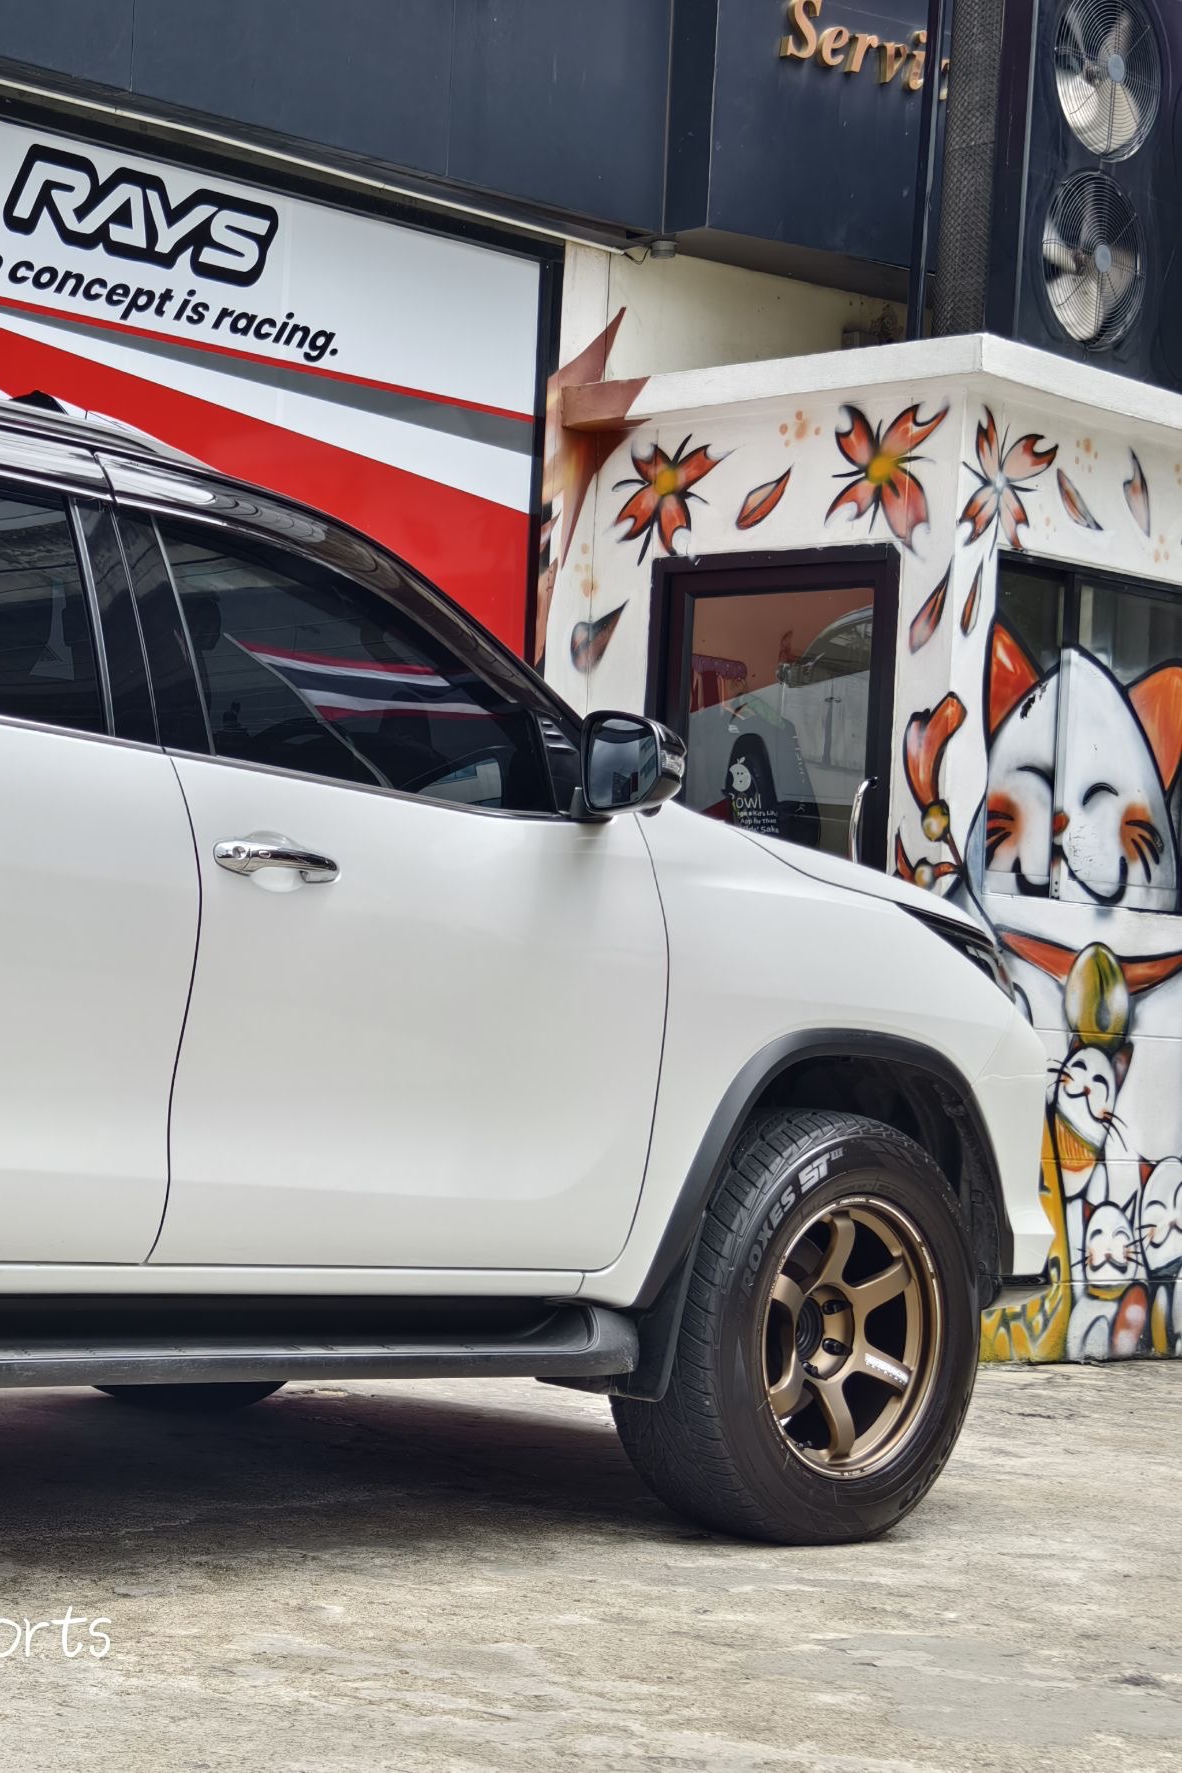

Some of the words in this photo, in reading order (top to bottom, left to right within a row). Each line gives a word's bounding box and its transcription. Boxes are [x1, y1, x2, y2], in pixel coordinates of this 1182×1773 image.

[6, 148, 276, 284] RAYS
[8, 259, 174, 320] concept
[175, 289, 208, 326] is
[213, 310, 339, 362] racing.
